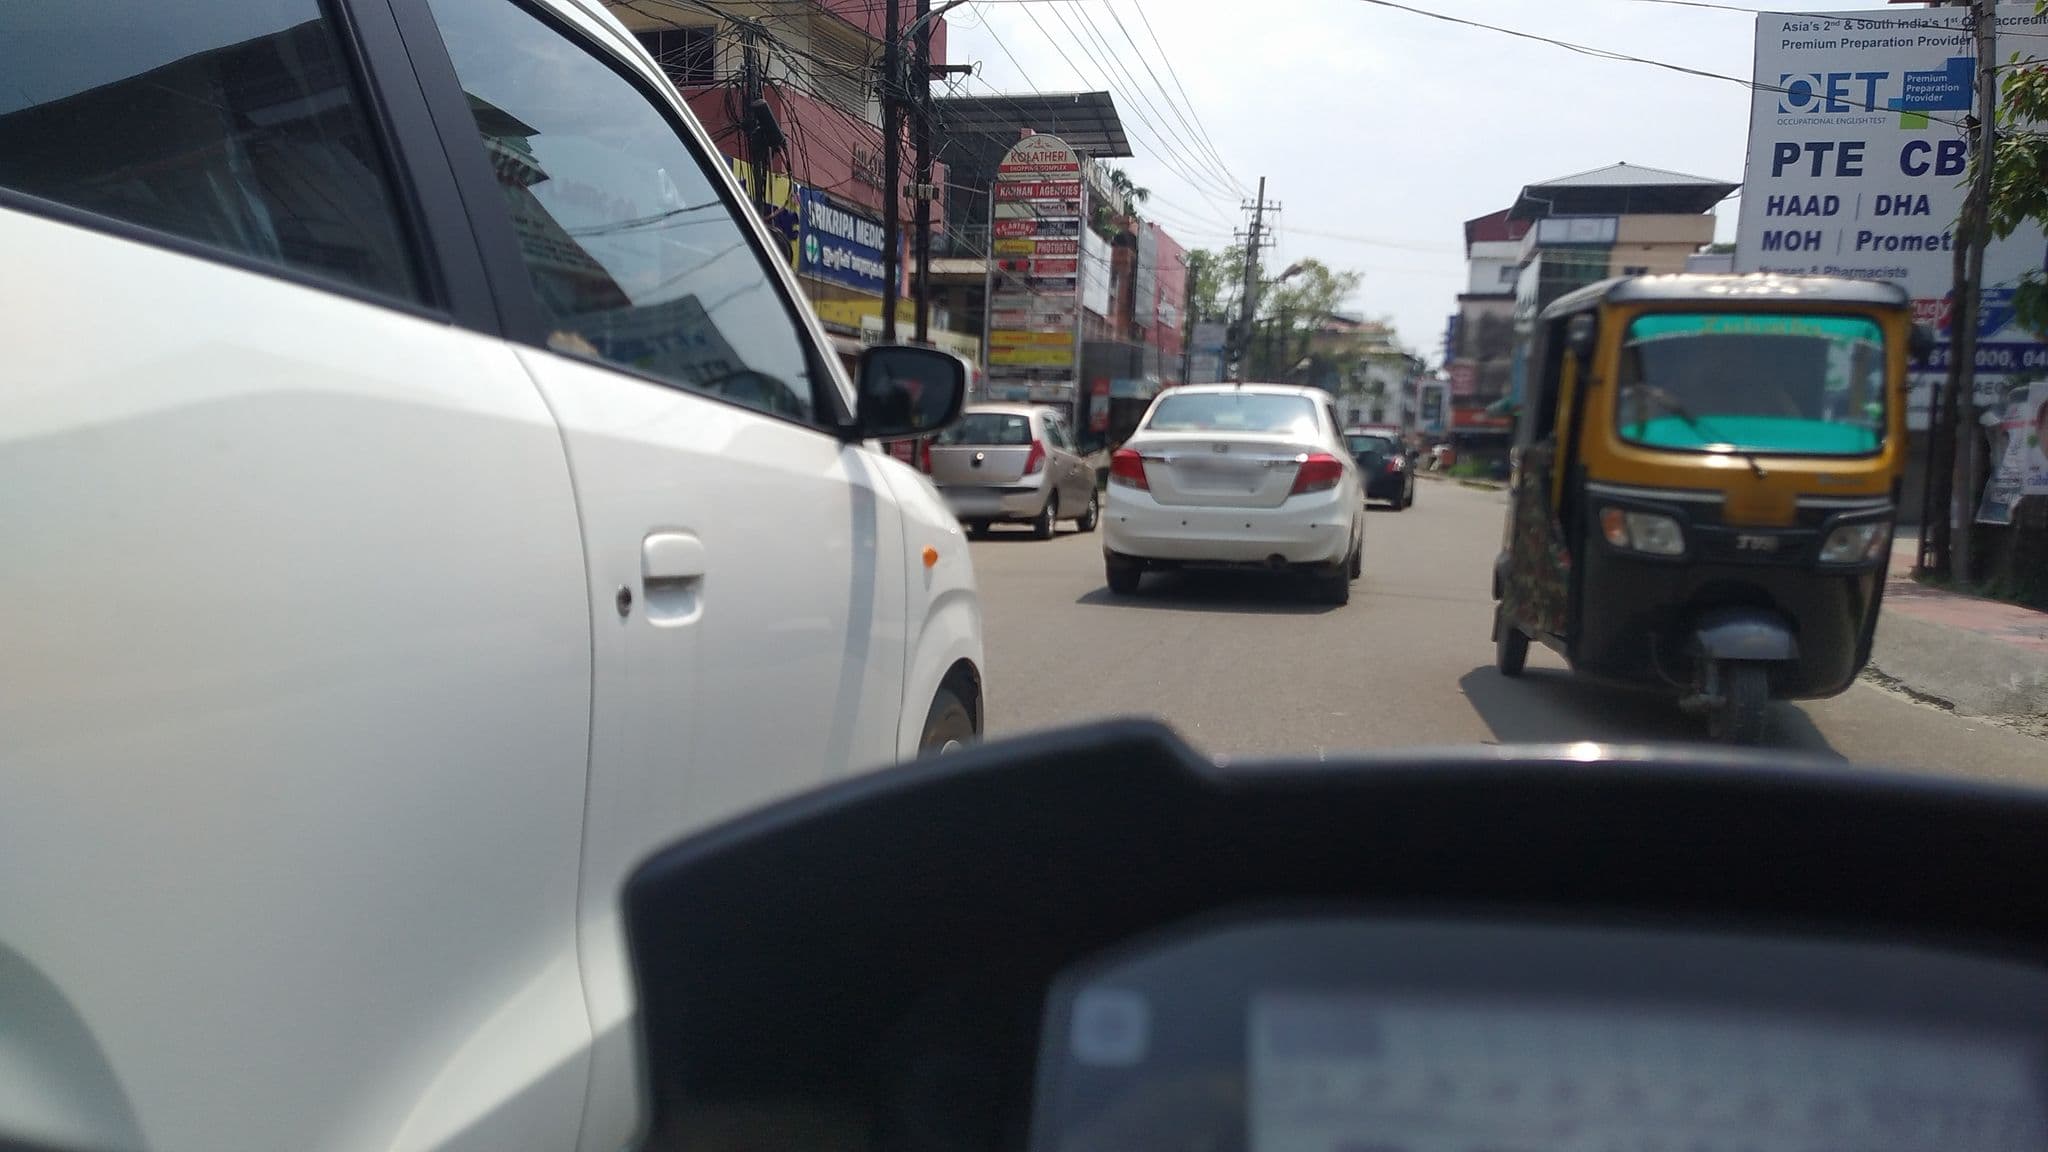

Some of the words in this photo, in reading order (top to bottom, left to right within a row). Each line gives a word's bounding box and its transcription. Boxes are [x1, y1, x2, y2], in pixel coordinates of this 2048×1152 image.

[1782, 21, 1819, 32] Asia's
[1844, 20, 1853, 30] &
[1857, 19, 1894, 30] South
[1898, 18, 1939, 29] India's
[1995, 15, 2048, 26] accredit
[1782, 38, 1836, 50] Premium
[1841, 37, 1913, 50] Preparation
[1918, 35, 1972, 48] Provider
[1907, 75, 1948, 84] Premium
[1778, 71, 1889, 114] OET
[1906, 83, 1960, 93] Preparation
[1905, 93, 1944, 103] Provider
[1777, 117, 1834, 126] OCCUPATIONAL
[1835, 117, 1868, 125] ENGLISH
[1869, 116, 1887, 125] TEST
[1010, 150, 1068, 163] KOLATHERI
[1771, 141, 1866, 178] PTE
[1900, 140, 1968, 177] CB
[1040, 185, 1079, 197] AGENCIES
[1766, 195, 1840, 216] HAAD
[1874, 194, 1931, 216] DHA
[807, 199, 855, 241] SRIKRIPA
[856, 218, 885, 251] MEDIC
[1761, 230, 1822, 251] MOH
[1855, 229, 1953, 251] Promet
[1824, 265, 1907, 278] Pharmacists
[2023, 350, 2048, 367] 04
